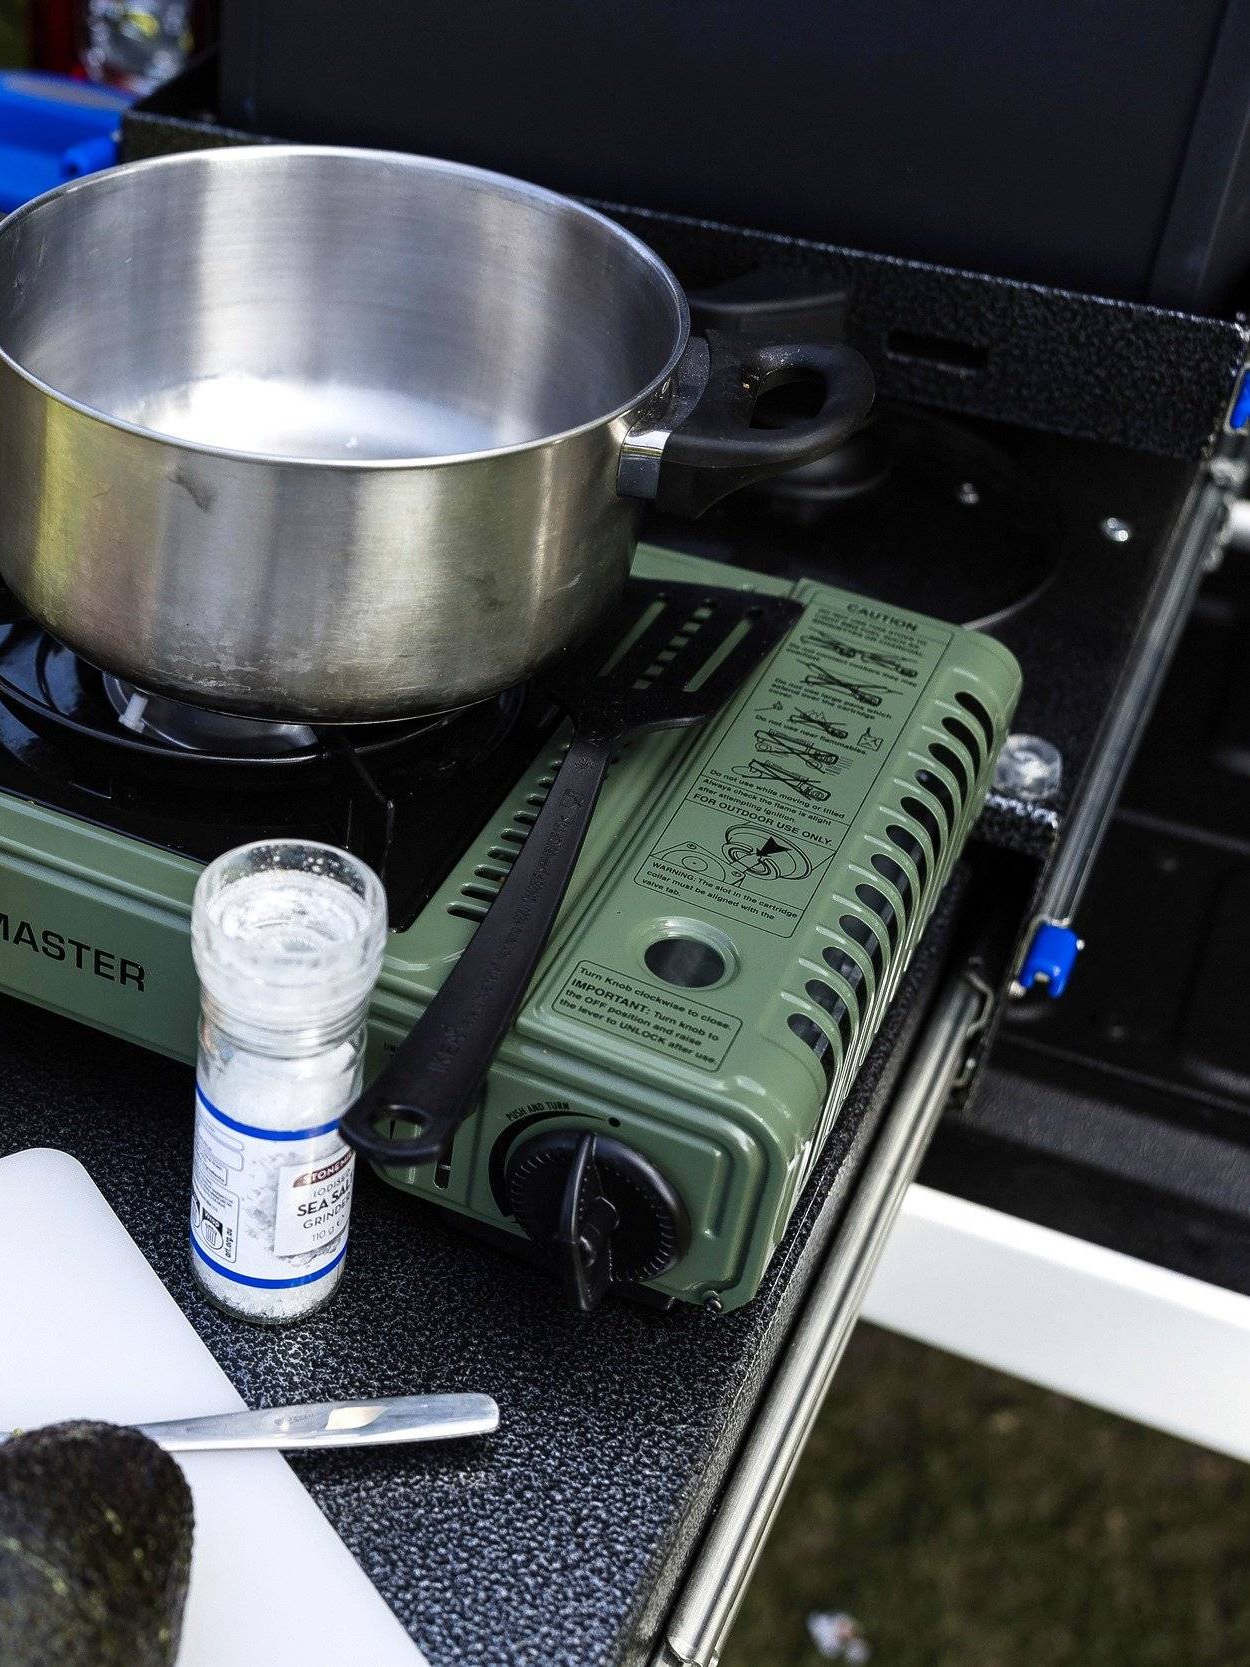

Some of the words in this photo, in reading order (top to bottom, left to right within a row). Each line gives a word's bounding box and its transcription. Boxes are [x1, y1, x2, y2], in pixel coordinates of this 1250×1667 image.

[845, 602, 918, 632] CAUTION
[783, 724, 798, 732] use
[799, 729, 818, 739] near
[697, 785, 718, 796] after
[717, 792, 762, 812] attempting
[762, 807, 797, 824] ignition.
[702, 777, 732, 792] Always
[732, 788, 758, 800] check
[758, 797, 773, 805] the
[773, 802, 797, 814] flame
[807, 813, 832, 826] alight
[709, 769, 722, 777] Do
[722, 774, 738, 782] not
[738, 779, 754, 788] use
[755, 785, 778, 796] while
[778, 793, 810, 808] moving
[822, 808, 845, 819] tilted
[692, 793, 718, 806] FOR
[717, 801, 774, 826] OUTDOOR
[775, 821, 800, 835] USE
[800, 830, 833, 846] ONLY.
[640, 878, 664, 890] valve
[664, 886, 682, 896] tab.
[645, 870, 671, 883] collar
[671, 879, 693, 891] must
[694, 887, 706, 895] be
[706, 891, 739, 908] aligned
[739, 903, 759, 914] with
[759, 910, 775, 920] the
[651, 861, 697, 882] WARNING:
[696, 877, 714, 888] The
[714, 884, 732, 894] slot
[732, 890, 742, 898] in
[742, 894, 758, 903] the
[757, 899, 799, 919] cartridge
[565, 989, 582, 1000] the
[585, 996, 606, 1008] OFF
[608, 1006, 650, 1027] position
[652, 1024, 674, 1035] and
[675, 1032, 702, 1046] raise
[571, 979, 652, 1014] IMPORTANT:
[654, 1011, 677, 1025] Turn
[679, 1021, 705, 1036] knob
[709, 1031, 719, 1041] to
[580, 966, 602, 980] Turn
[604, 977, 632, 992] Knob
[635, 989, 686, 1012] clockwise
[688, 1007, 698, 1017] to
[701, 1014, 732, 1030] close.
[559, 999, 576, 1010] the
[579, 1005, 604, 1020] lever
[606, 1015, 617, 1025] to
[619, 1021, 666, 1045] UNLOCK
[668, 1040, 694, 1054] after
[695, 1052, 716, 1064] use.
[505, 1106, 527, 1121] PUSH
[527, 1103, 545, 1112] AND
[545, 1101, 570, 1110] TURN
[297, 1198, 328, 1217] SEA
[313, 1230, 326, 1242] 110
